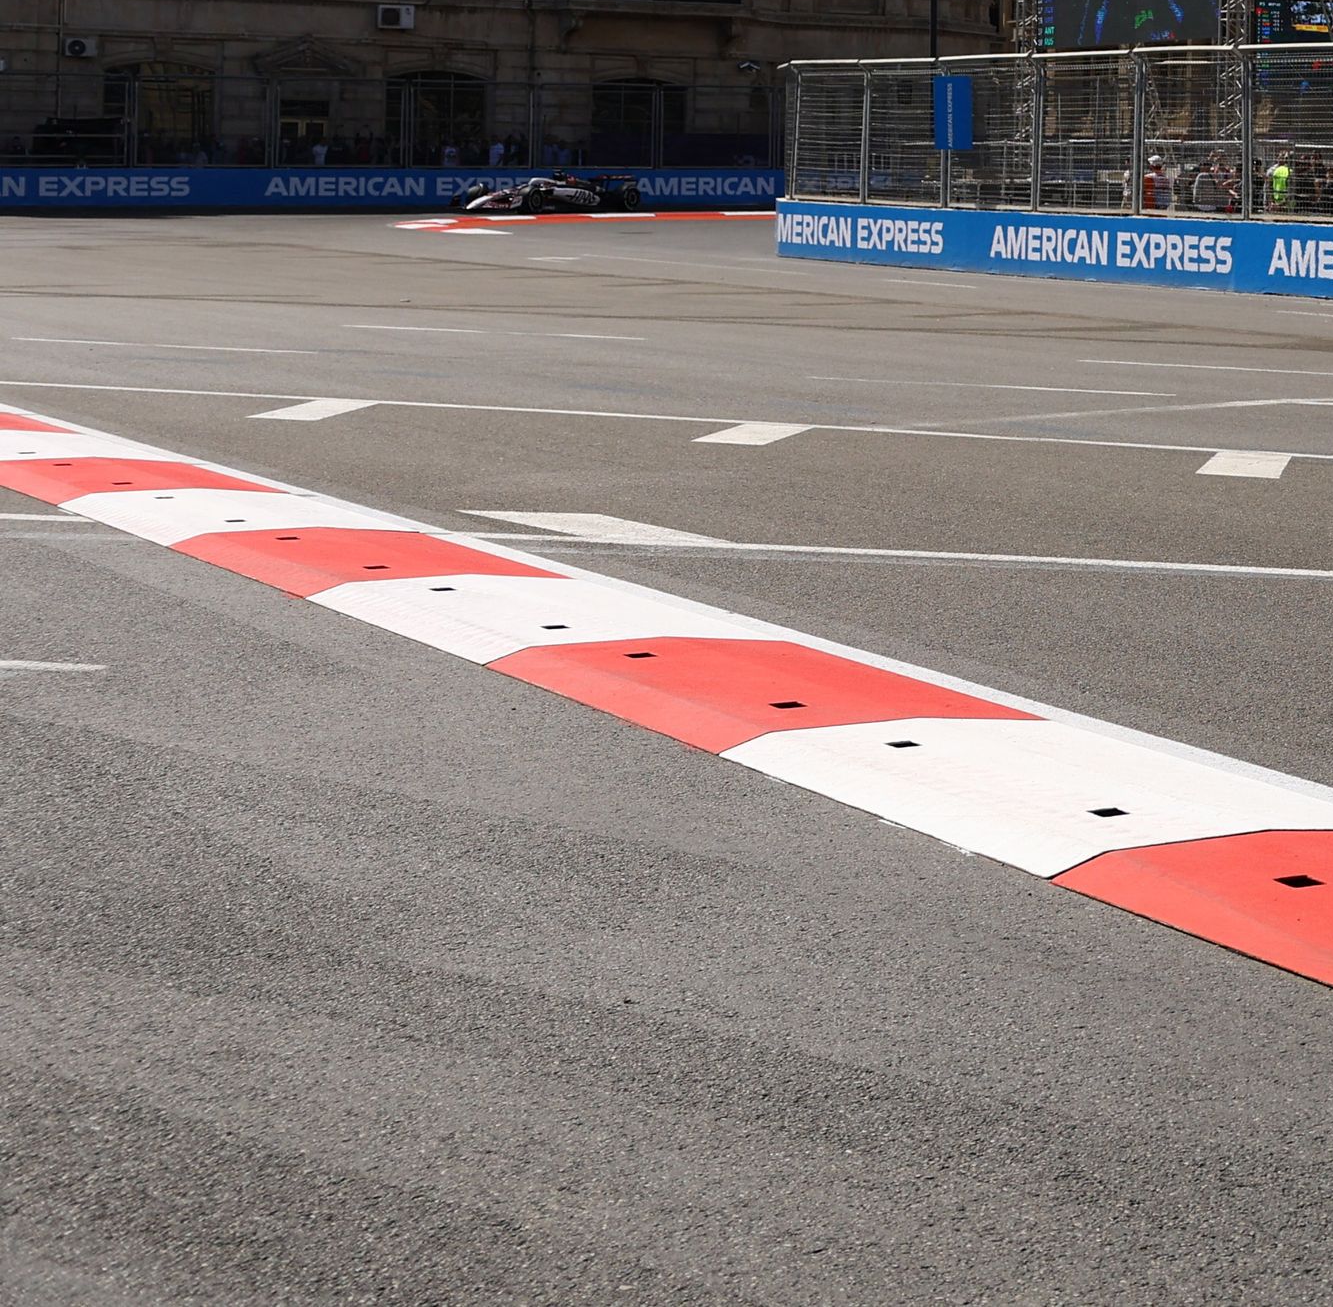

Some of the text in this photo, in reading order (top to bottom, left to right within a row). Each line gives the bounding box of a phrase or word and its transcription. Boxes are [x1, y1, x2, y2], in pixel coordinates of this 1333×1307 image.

[38, 176, 191, 197] EXPRESS
[264, 176, 425, 196] AMERICAN
[637, 176, 775, 196] AMERICAN
[856, 218, 944, 254] EXPRESS
[990, 224, 1233, 275] AMERICAN EXPRESS
